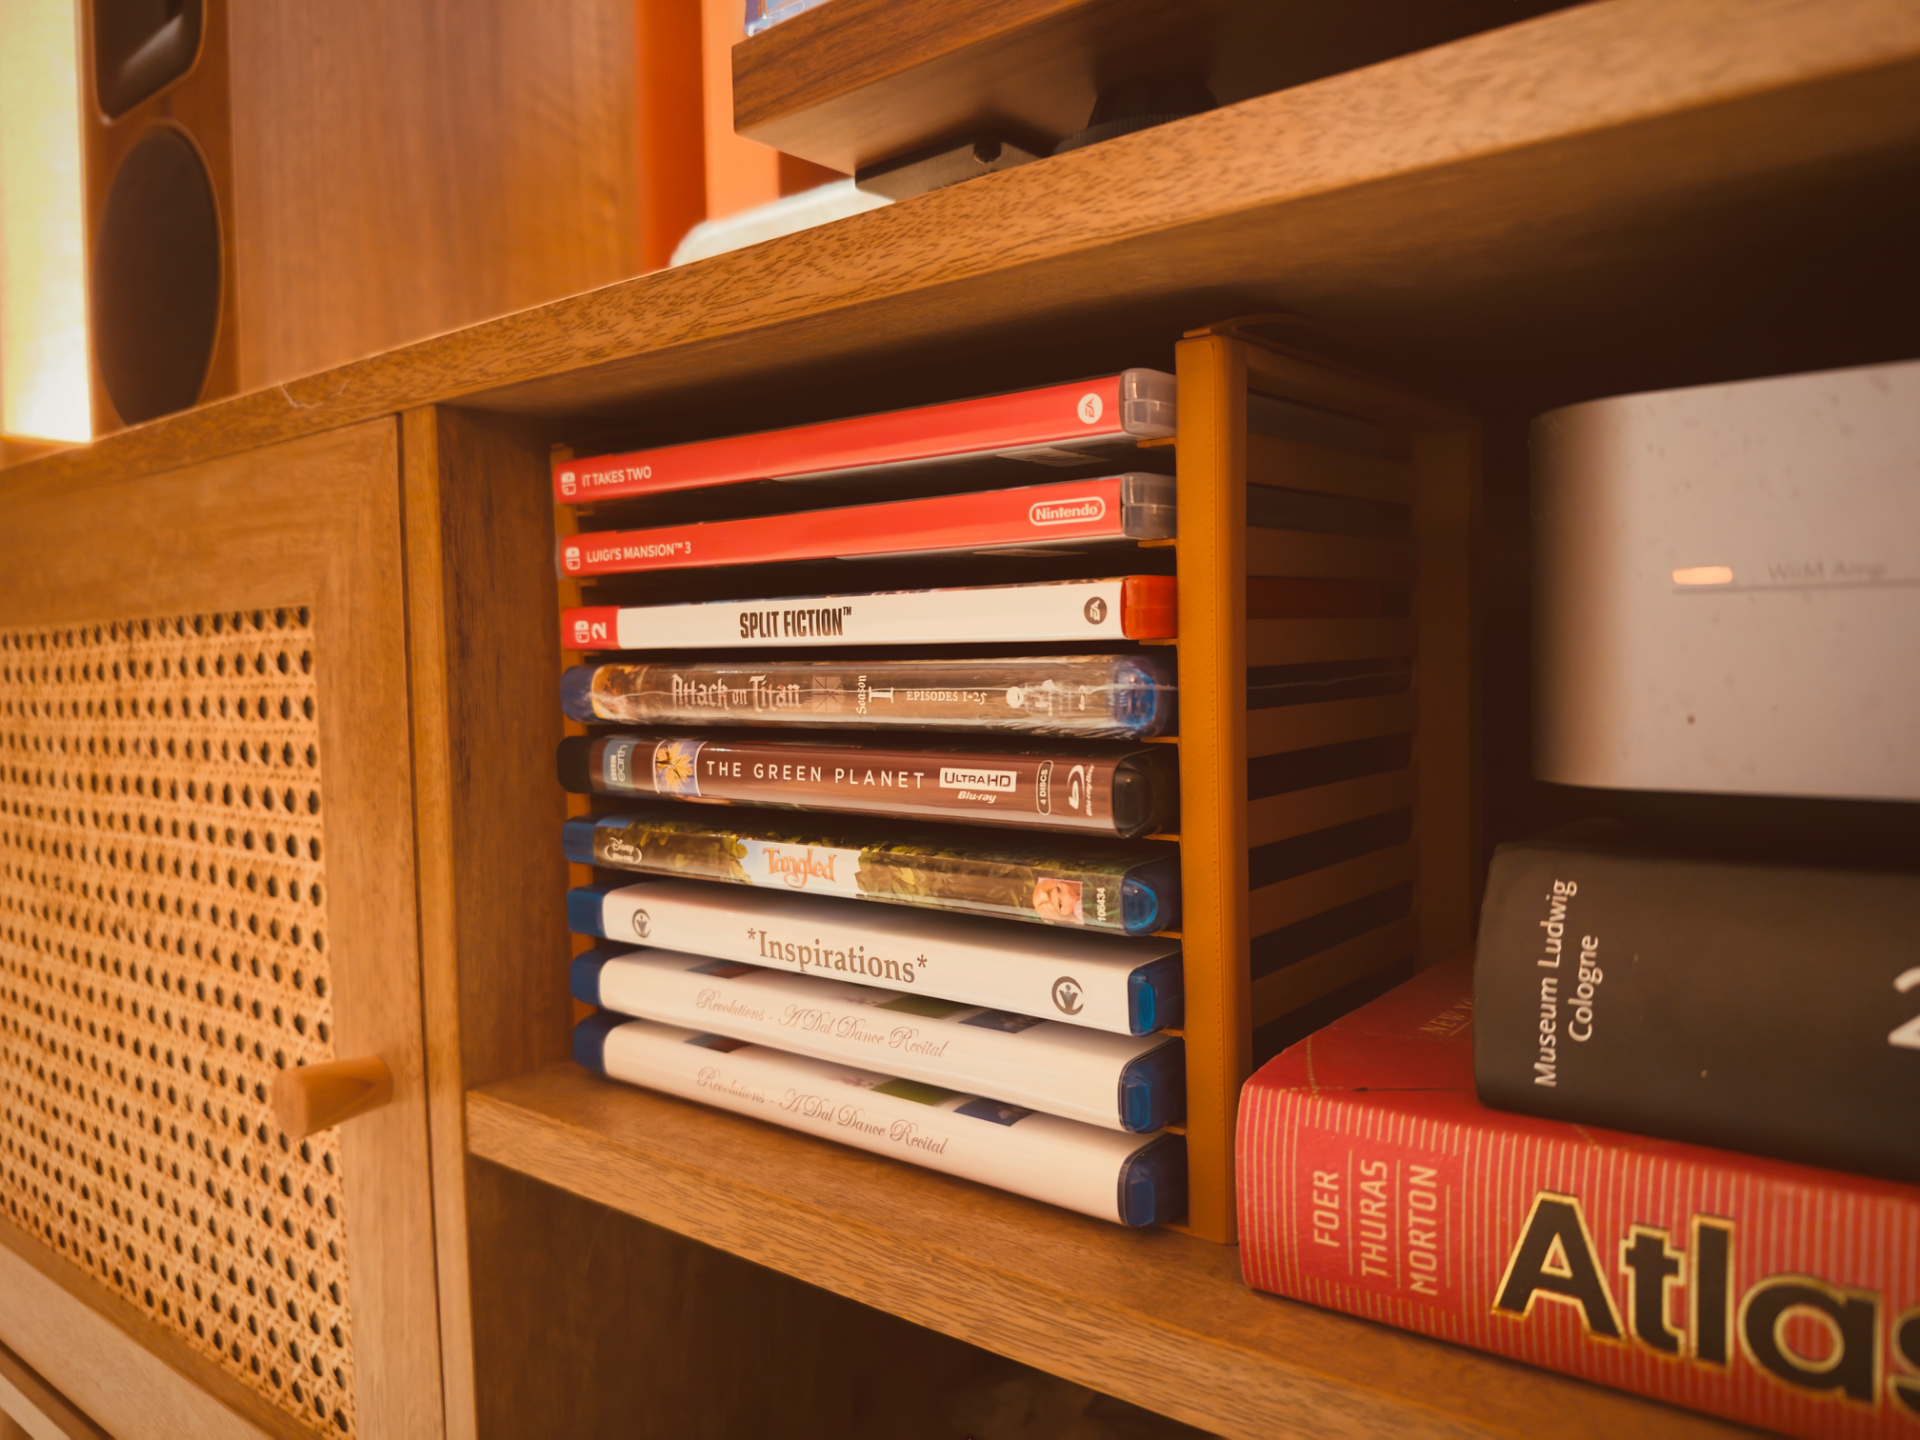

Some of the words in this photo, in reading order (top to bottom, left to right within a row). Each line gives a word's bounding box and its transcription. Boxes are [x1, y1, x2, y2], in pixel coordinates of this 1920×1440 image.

[582, 474, 591, 488] IT
[592, 469, 625, 486] TAKES
[626, 466, 652, 481] TWO
[1035, 503, 1099, 521] Nintendo
[587, 547, 622, 563] LUIGI'S
[623, 542, 683, 560] MANSION™
[684, 541, 692, 555] 3
[740, 611, 780, 638] SPLIT
[783, 606, 853, 637] FICTION™
[1088, 599, 1101, 622] EA
[591, 621, 607, 640] 2
[671, 673, 731, 711] Attack
[732, 689, 748, 705] on
[748, 674, 804, 713] Titan
[856, 674, 867, 715] Season
[906, 690, 959, 702] EPISODES
[617, 744, 629, 782] earth
[706, 761, 742, 778] THE
[753, 763, 822, 782] GREEN
[834, 768, 924, 788] PLANET
[957, 790, 997, 805] Blu-ray
[1039, 768, 1048, 798] DISCS
[1040, 798, 1047, 806] 4
[762, 848, 837, 889] Tangled
[1096, 886, 1107, 922] 106434
[1537, 878, 1578, 969] Ludwig
[1567, 934, 1604, 1043] Cologne
[696, 988, 765, 1021] Revolutions
[835, 1016, 885, 1046] Dance
[888, 1026, 949, 1059] Recital
[1533, 976, 1559, 1088] Museum
[697, 1066, 765, 1104] Revolutions
[837, 1105, 886, 1138] Dance
[889, 1119, 950, 1156] Recital
[1313, 1168, 1340, 1248] FOER
[1361, 1159, 1388, 1278] THURAS
[1408, 1164, 1439, 1296] MORTON
[1491, 1190, 1920, 1422] Atla
